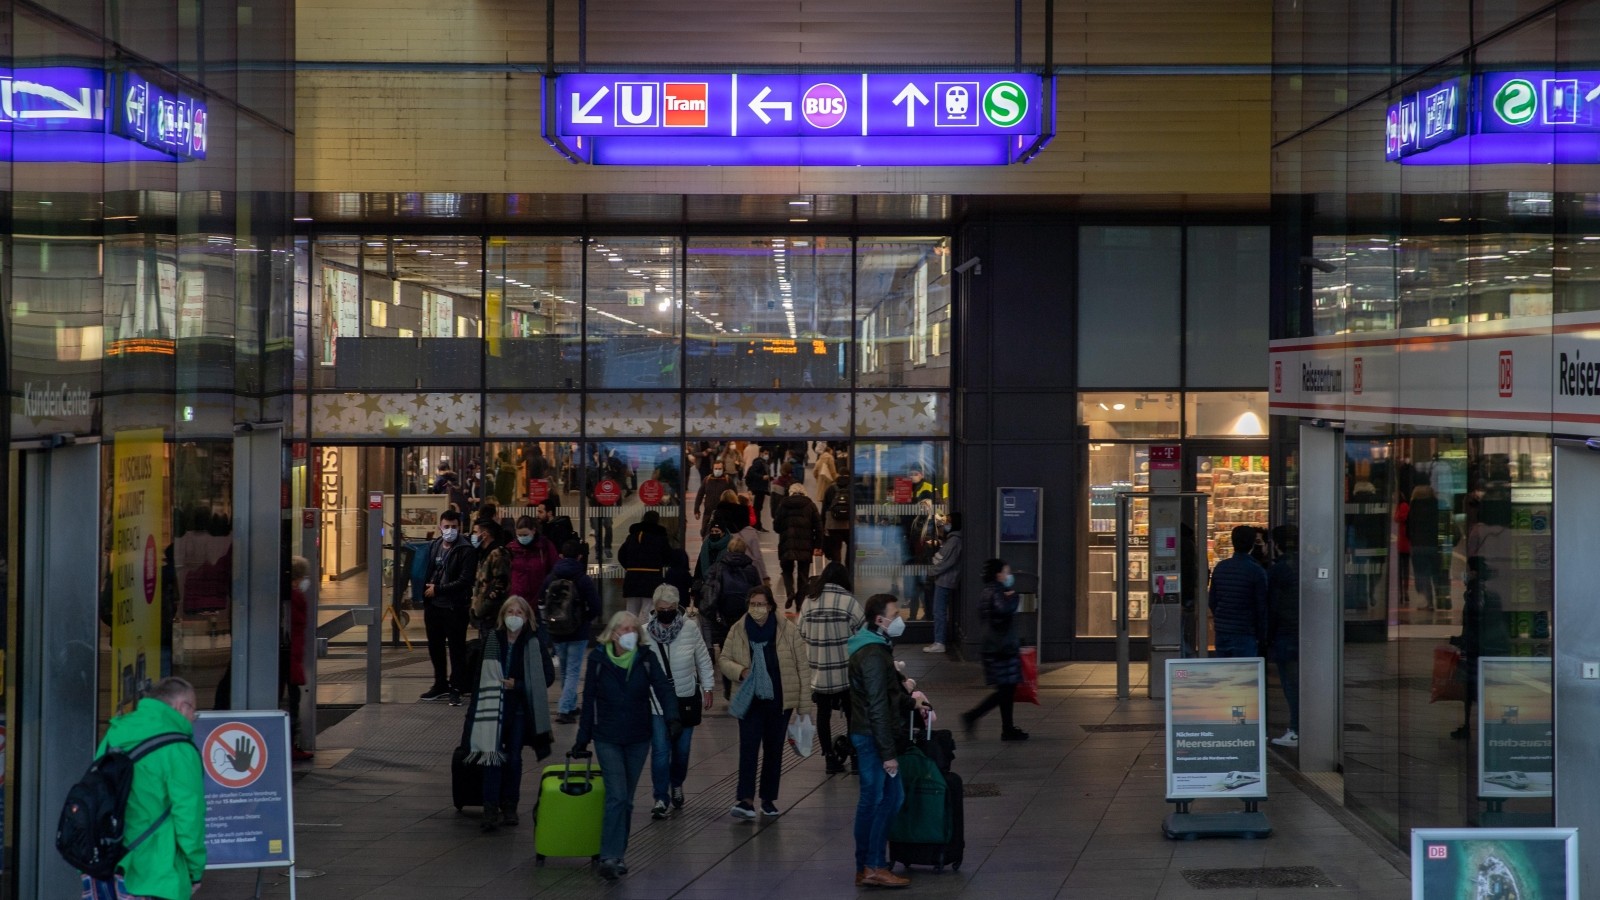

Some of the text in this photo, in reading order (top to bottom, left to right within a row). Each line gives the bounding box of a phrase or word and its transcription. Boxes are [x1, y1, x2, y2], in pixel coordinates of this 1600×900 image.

[622, 86, 1020, 124] U Tram BUS S
[1500, 350, 1600, 396] DB Reisez
[24, 381, 90, 416] KundenCenter
[1176, 739, 1255, 748] Meeresrauschen
[1430, 847, 1445, 857] DB
